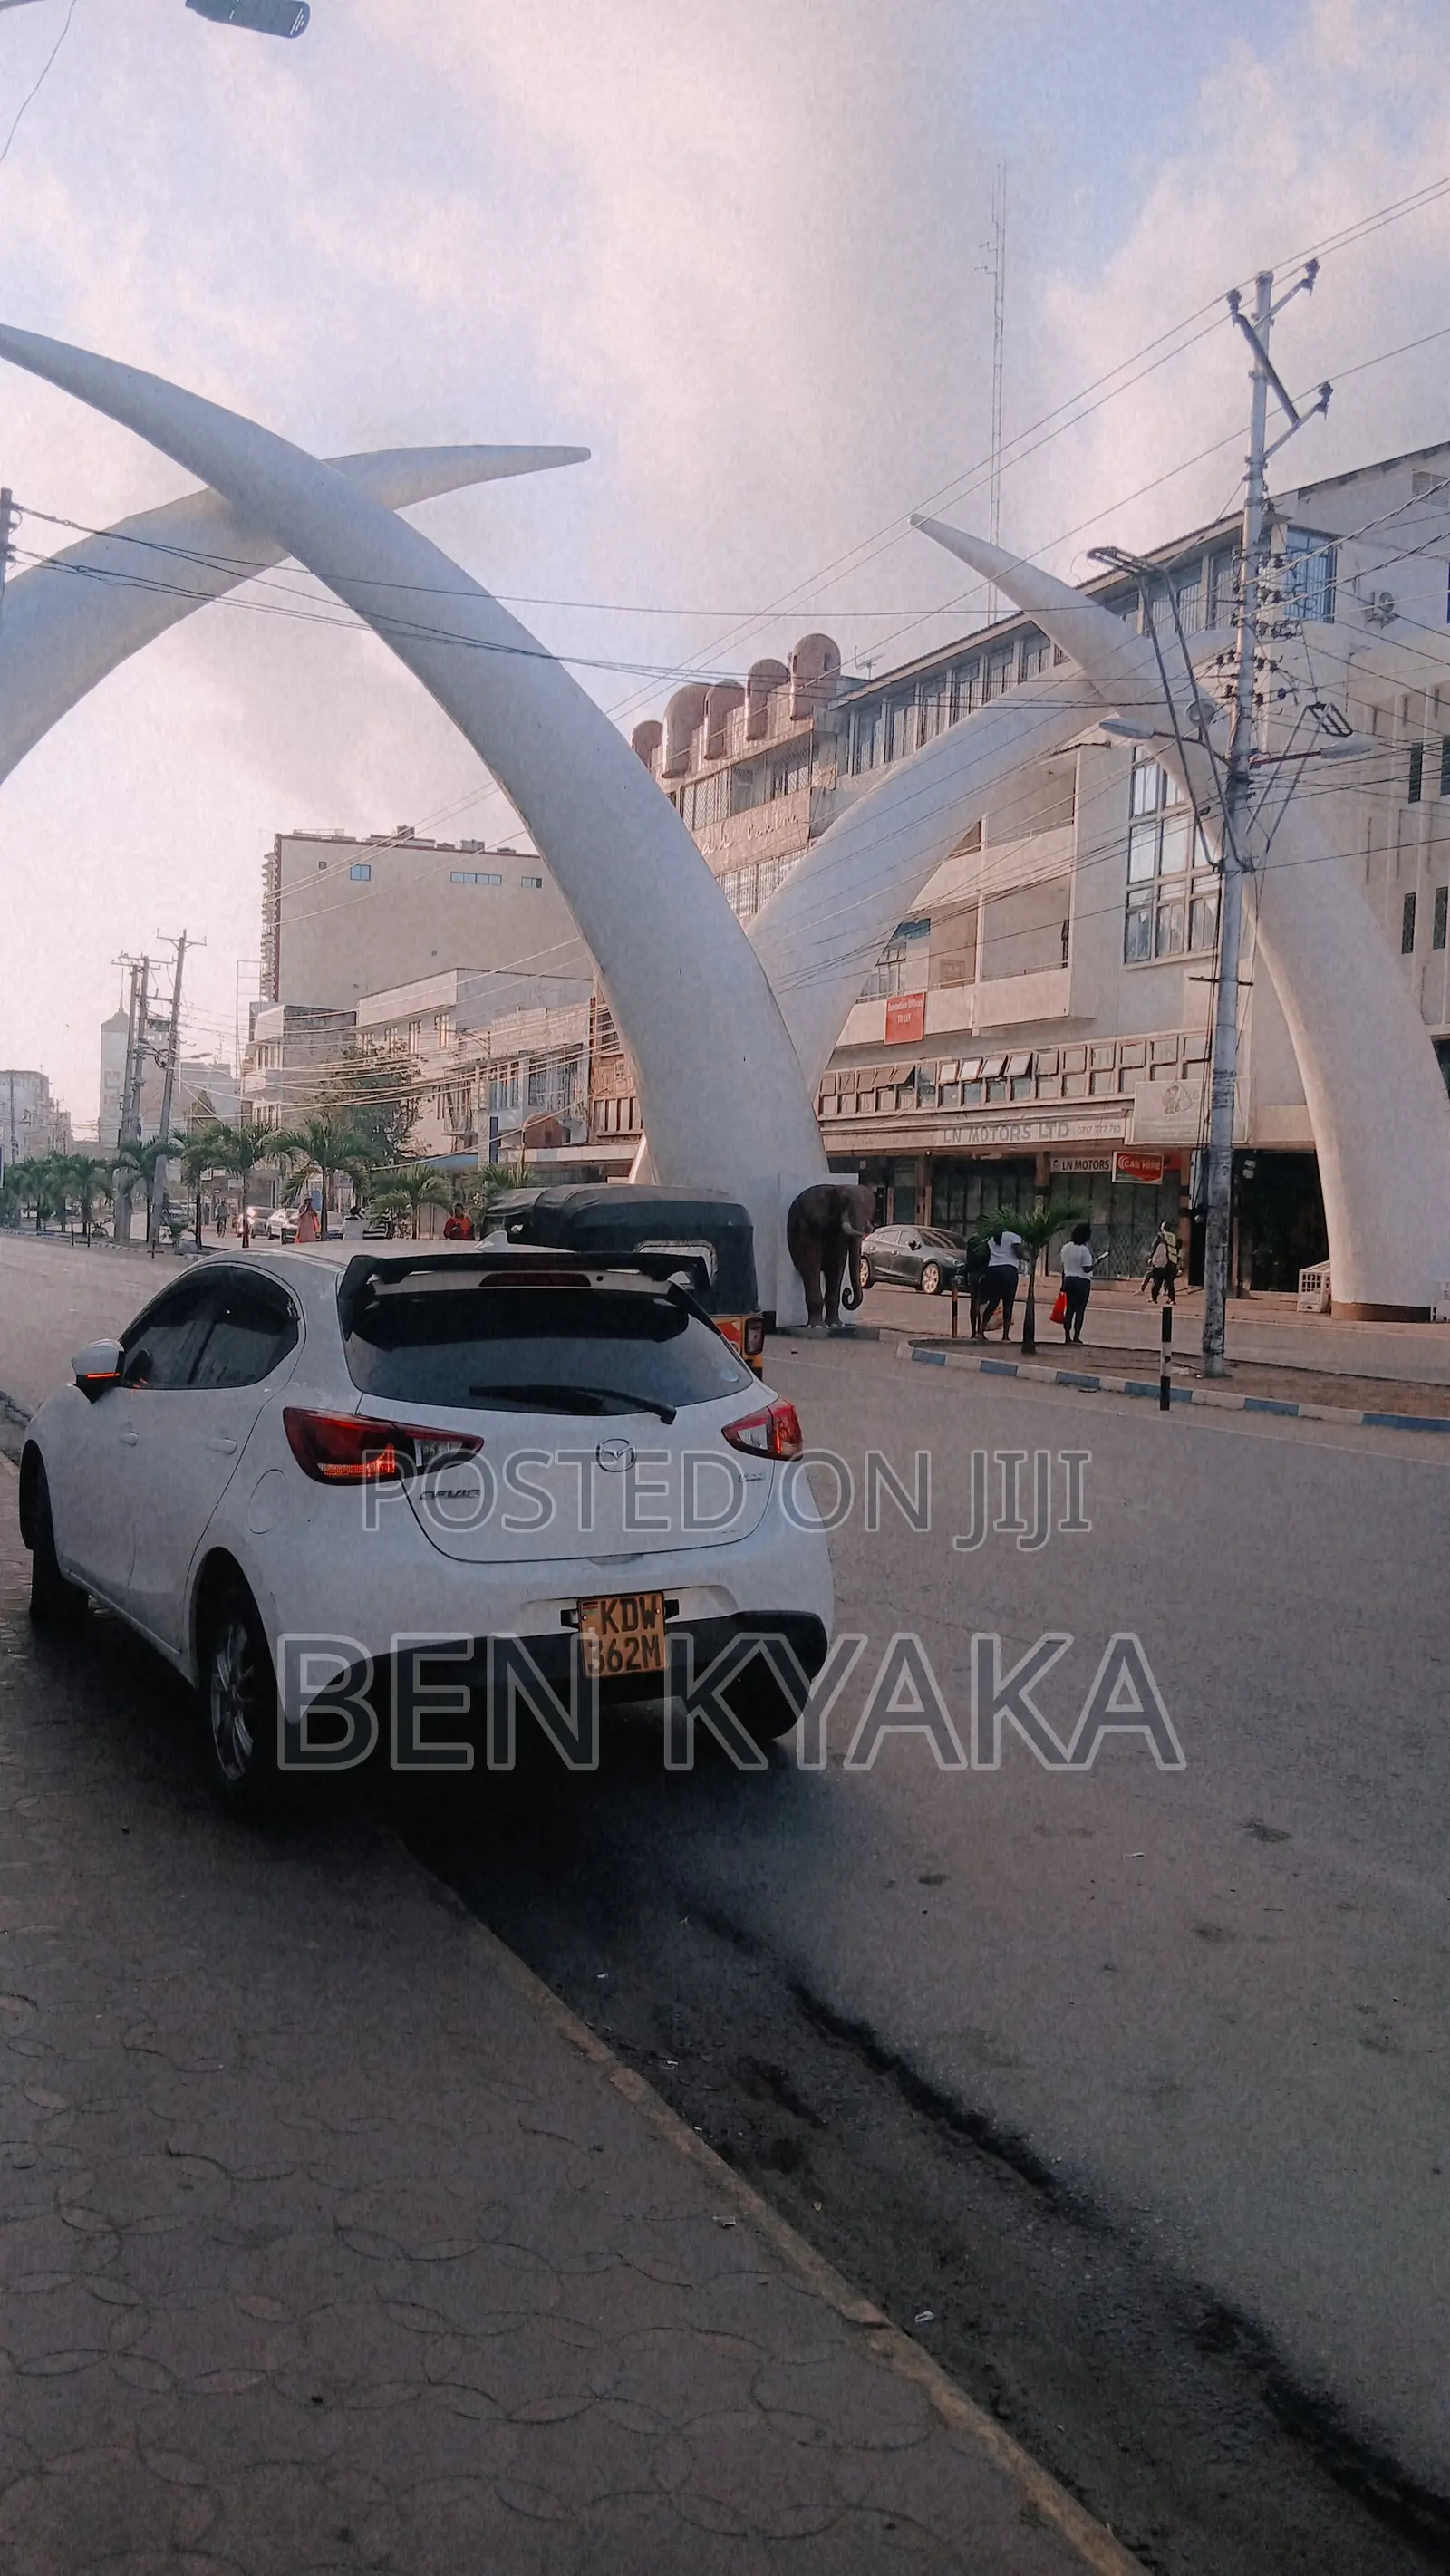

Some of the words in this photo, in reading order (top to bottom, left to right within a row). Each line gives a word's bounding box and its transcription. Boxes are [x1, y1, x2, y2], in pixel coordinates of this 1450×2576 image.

[943, 1128, 962, 1143] LN
[968, 1123, 1031, 1143] MOTORS
[1038, 1121, 1069, 1138] LTD
[1062, 1160, 1072, 1171] LN
[1075, 1159, 1109, 1171] MOTORS
[600, 1594, 657, 1635] KDW
[587, 1634, 662, 1674] 362M
